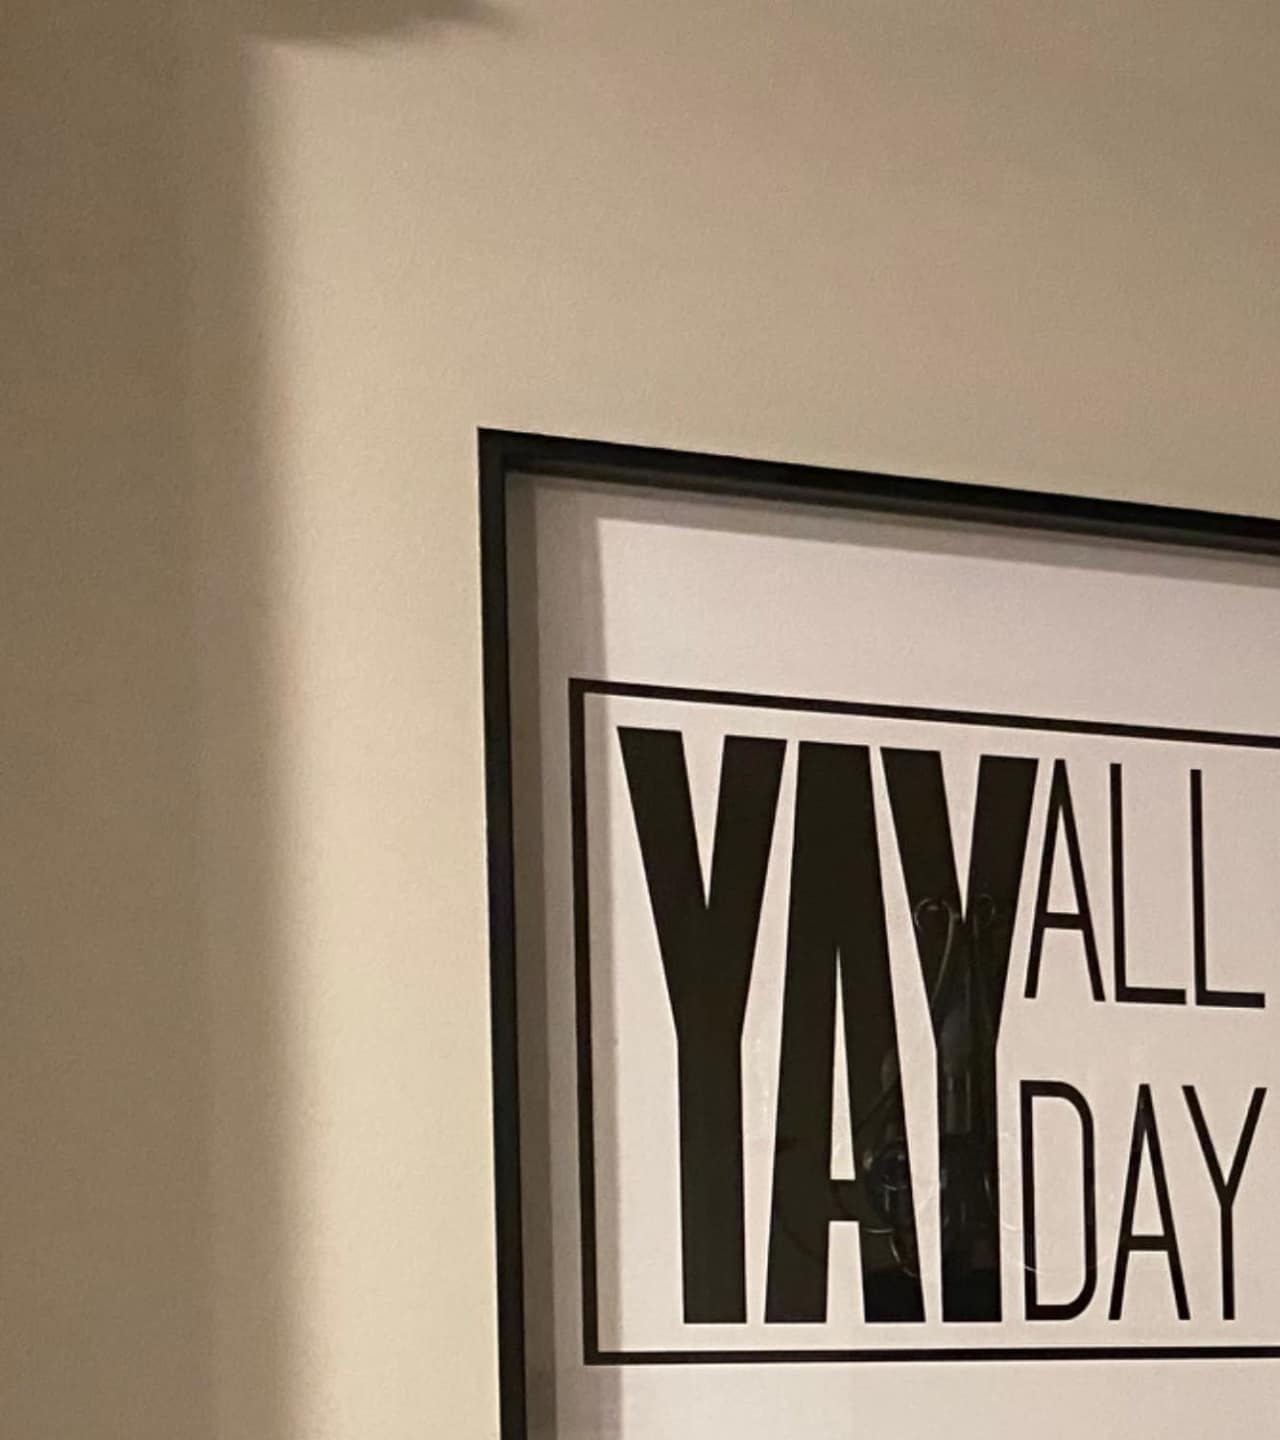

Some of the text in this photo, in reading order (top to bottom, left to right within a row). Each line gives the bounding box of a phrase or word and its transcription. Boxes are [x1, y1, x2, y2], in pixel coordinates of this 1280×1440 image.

[1024, 758, 1265, 1009] ALL
[617, 726, 1040, 1324] YAY
[1020, 1079, 1267, 1321] DAY
